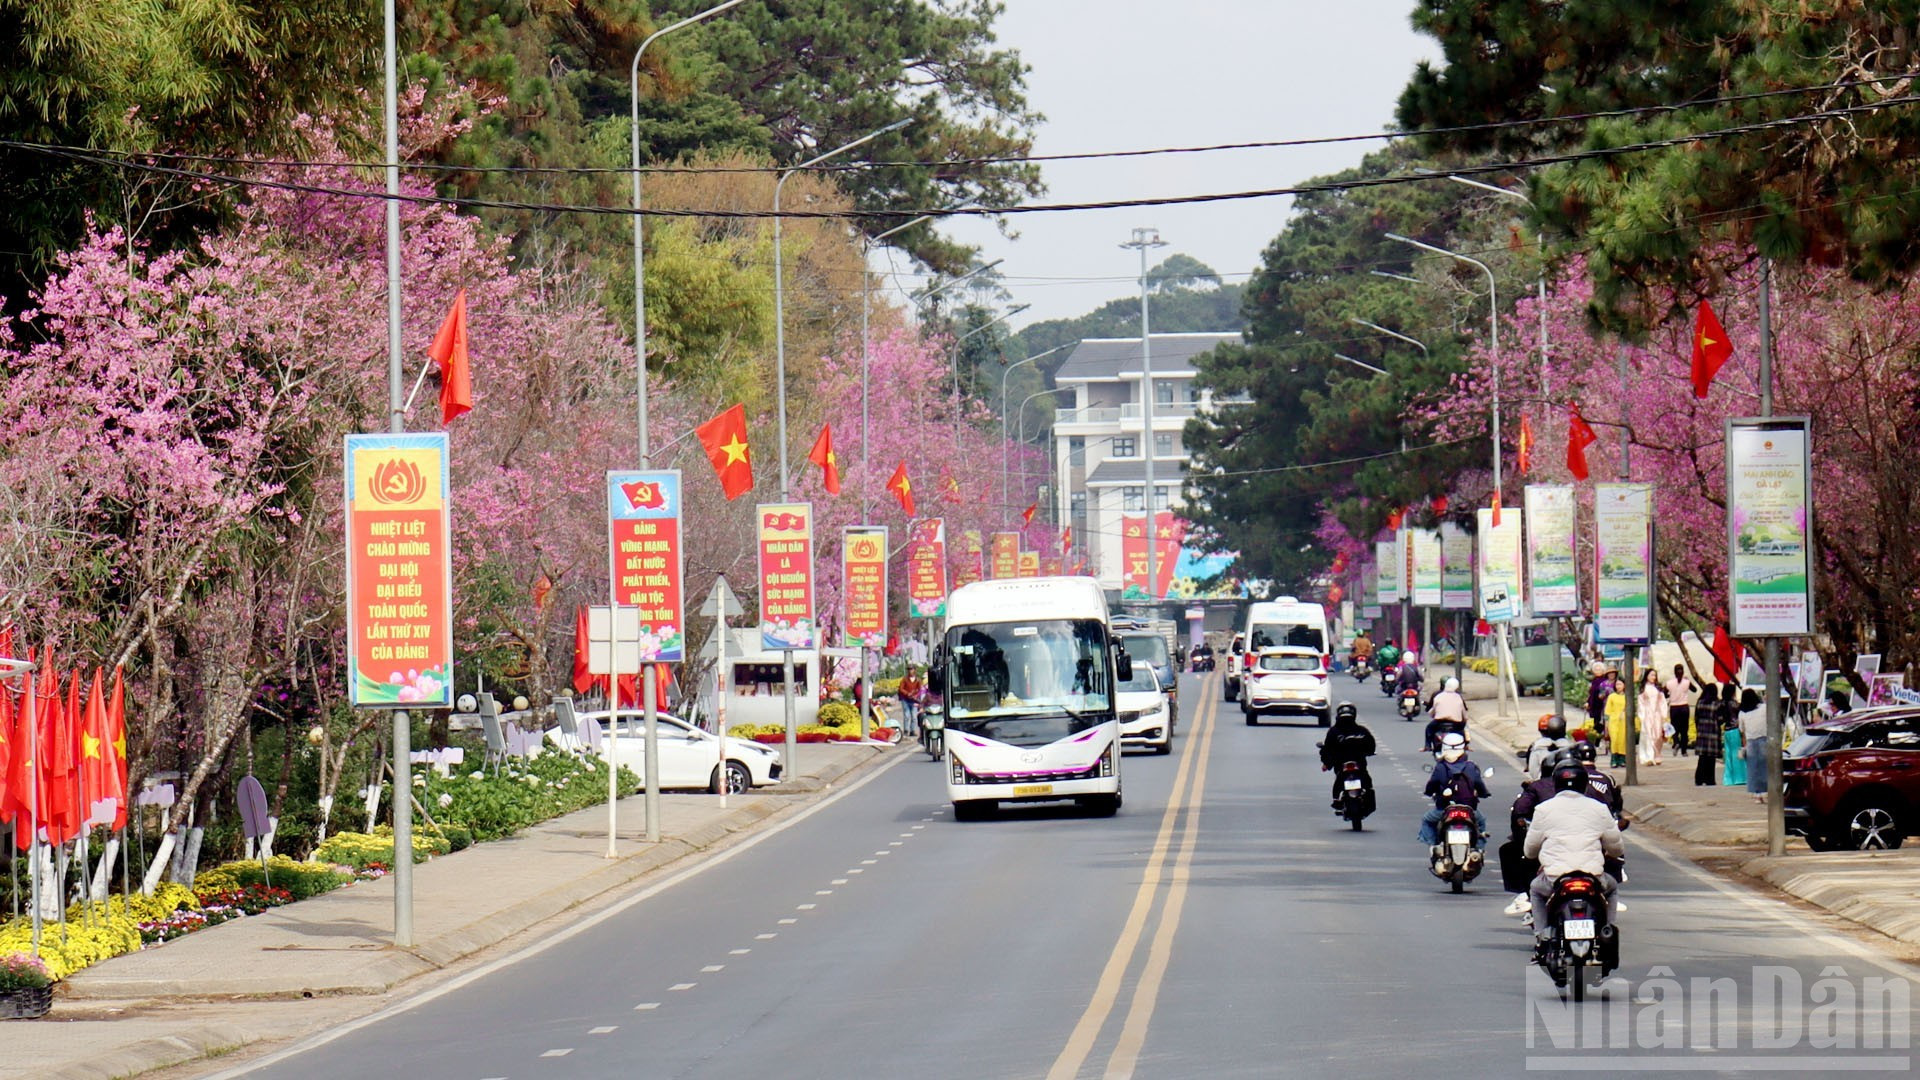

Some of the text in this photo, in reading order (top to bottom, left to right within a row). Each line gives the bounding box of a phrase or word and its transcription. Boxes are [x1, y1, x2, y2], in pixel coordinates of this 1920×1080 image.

[371, 519, 426, 538] NHIỆT LIỆT
[634, 520, 657, 535] ĐẢNG
[367, 540, 430, 557] CHÀO MỪNG
[621, 539, 642, 552] VỮNG
[379, 560, 419, 580] ĐẠI HỘI
[626, 554, 666, 570] ĐẤT NƯỚC
[622, 573, 643, 587] PHÁT
[376, 578, 422, 600] ĐẠI BIỂU
[630, 589, 665, 606] DÂN TỘC
[368, 600, 428, 619] TOÀN QUỐC
[390, 622, 412, 639] THỨ
[413, 624, 431, 638] XIV
[371, 642, 429, 660] CỦA ĐẢNG!
[1893, 685, 1920, 704] Vietin
